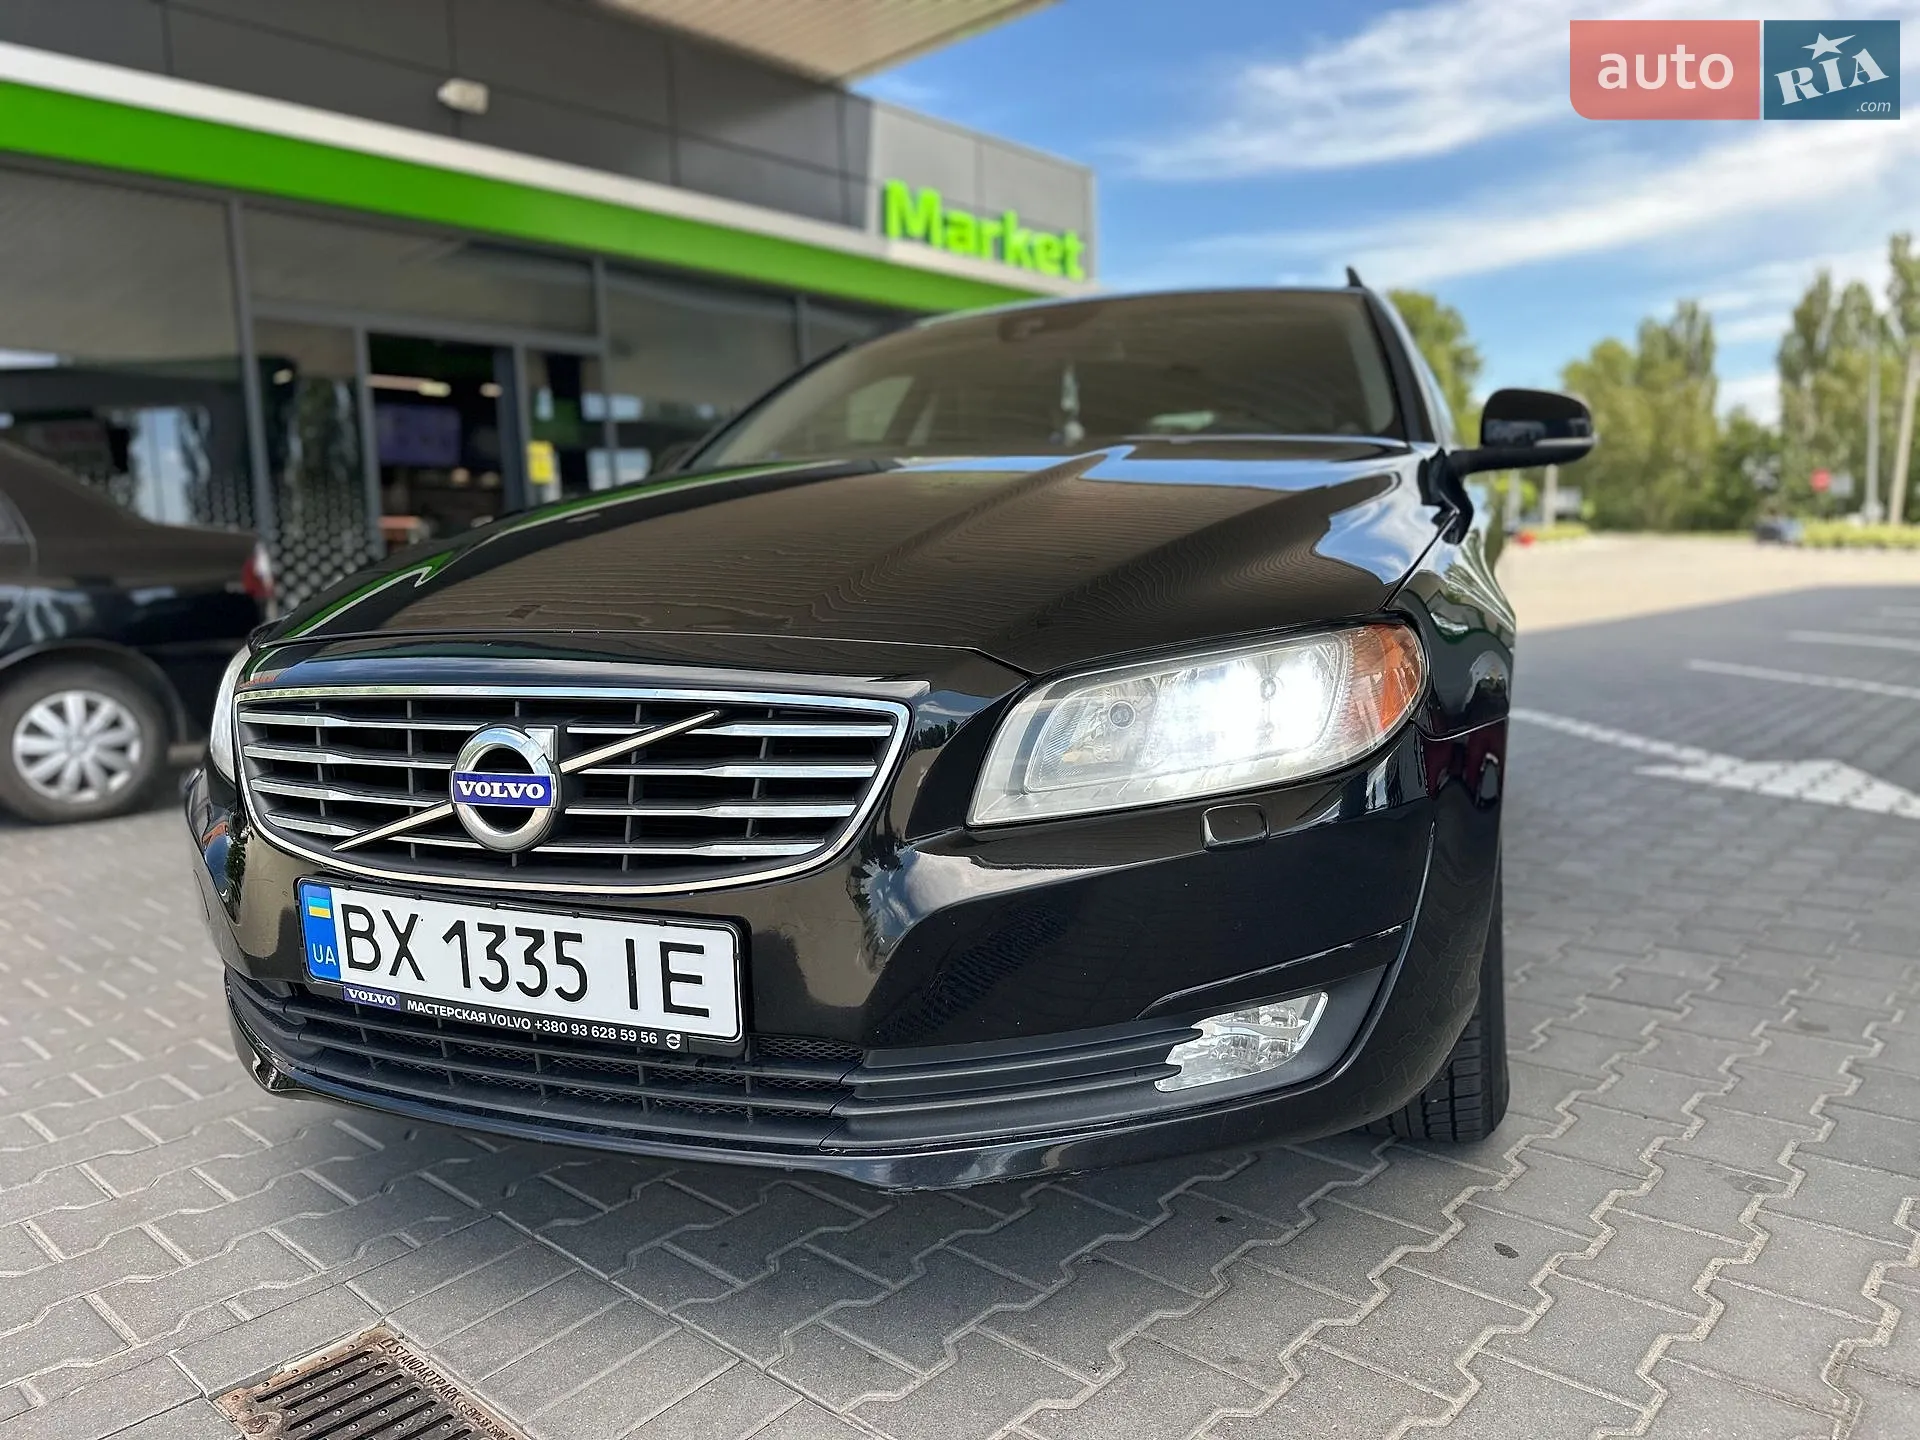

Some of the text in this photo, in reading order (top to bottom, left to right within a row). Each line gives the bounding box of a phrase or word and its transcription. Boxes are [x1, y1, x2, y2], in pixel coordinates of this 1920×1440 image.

[884, 179, 1085, 282] Market
[457, 780, 545, 799] VOLVO
[311, 943, 337, 966] UA
[341, 903, 710, 1018] BX 1335 IE
[346, 988, 397, 1007] VOLVO
[407, 1000, 658, 1045] МАСТЕРСКАЯ VOLVO +380 93 628 59 56
